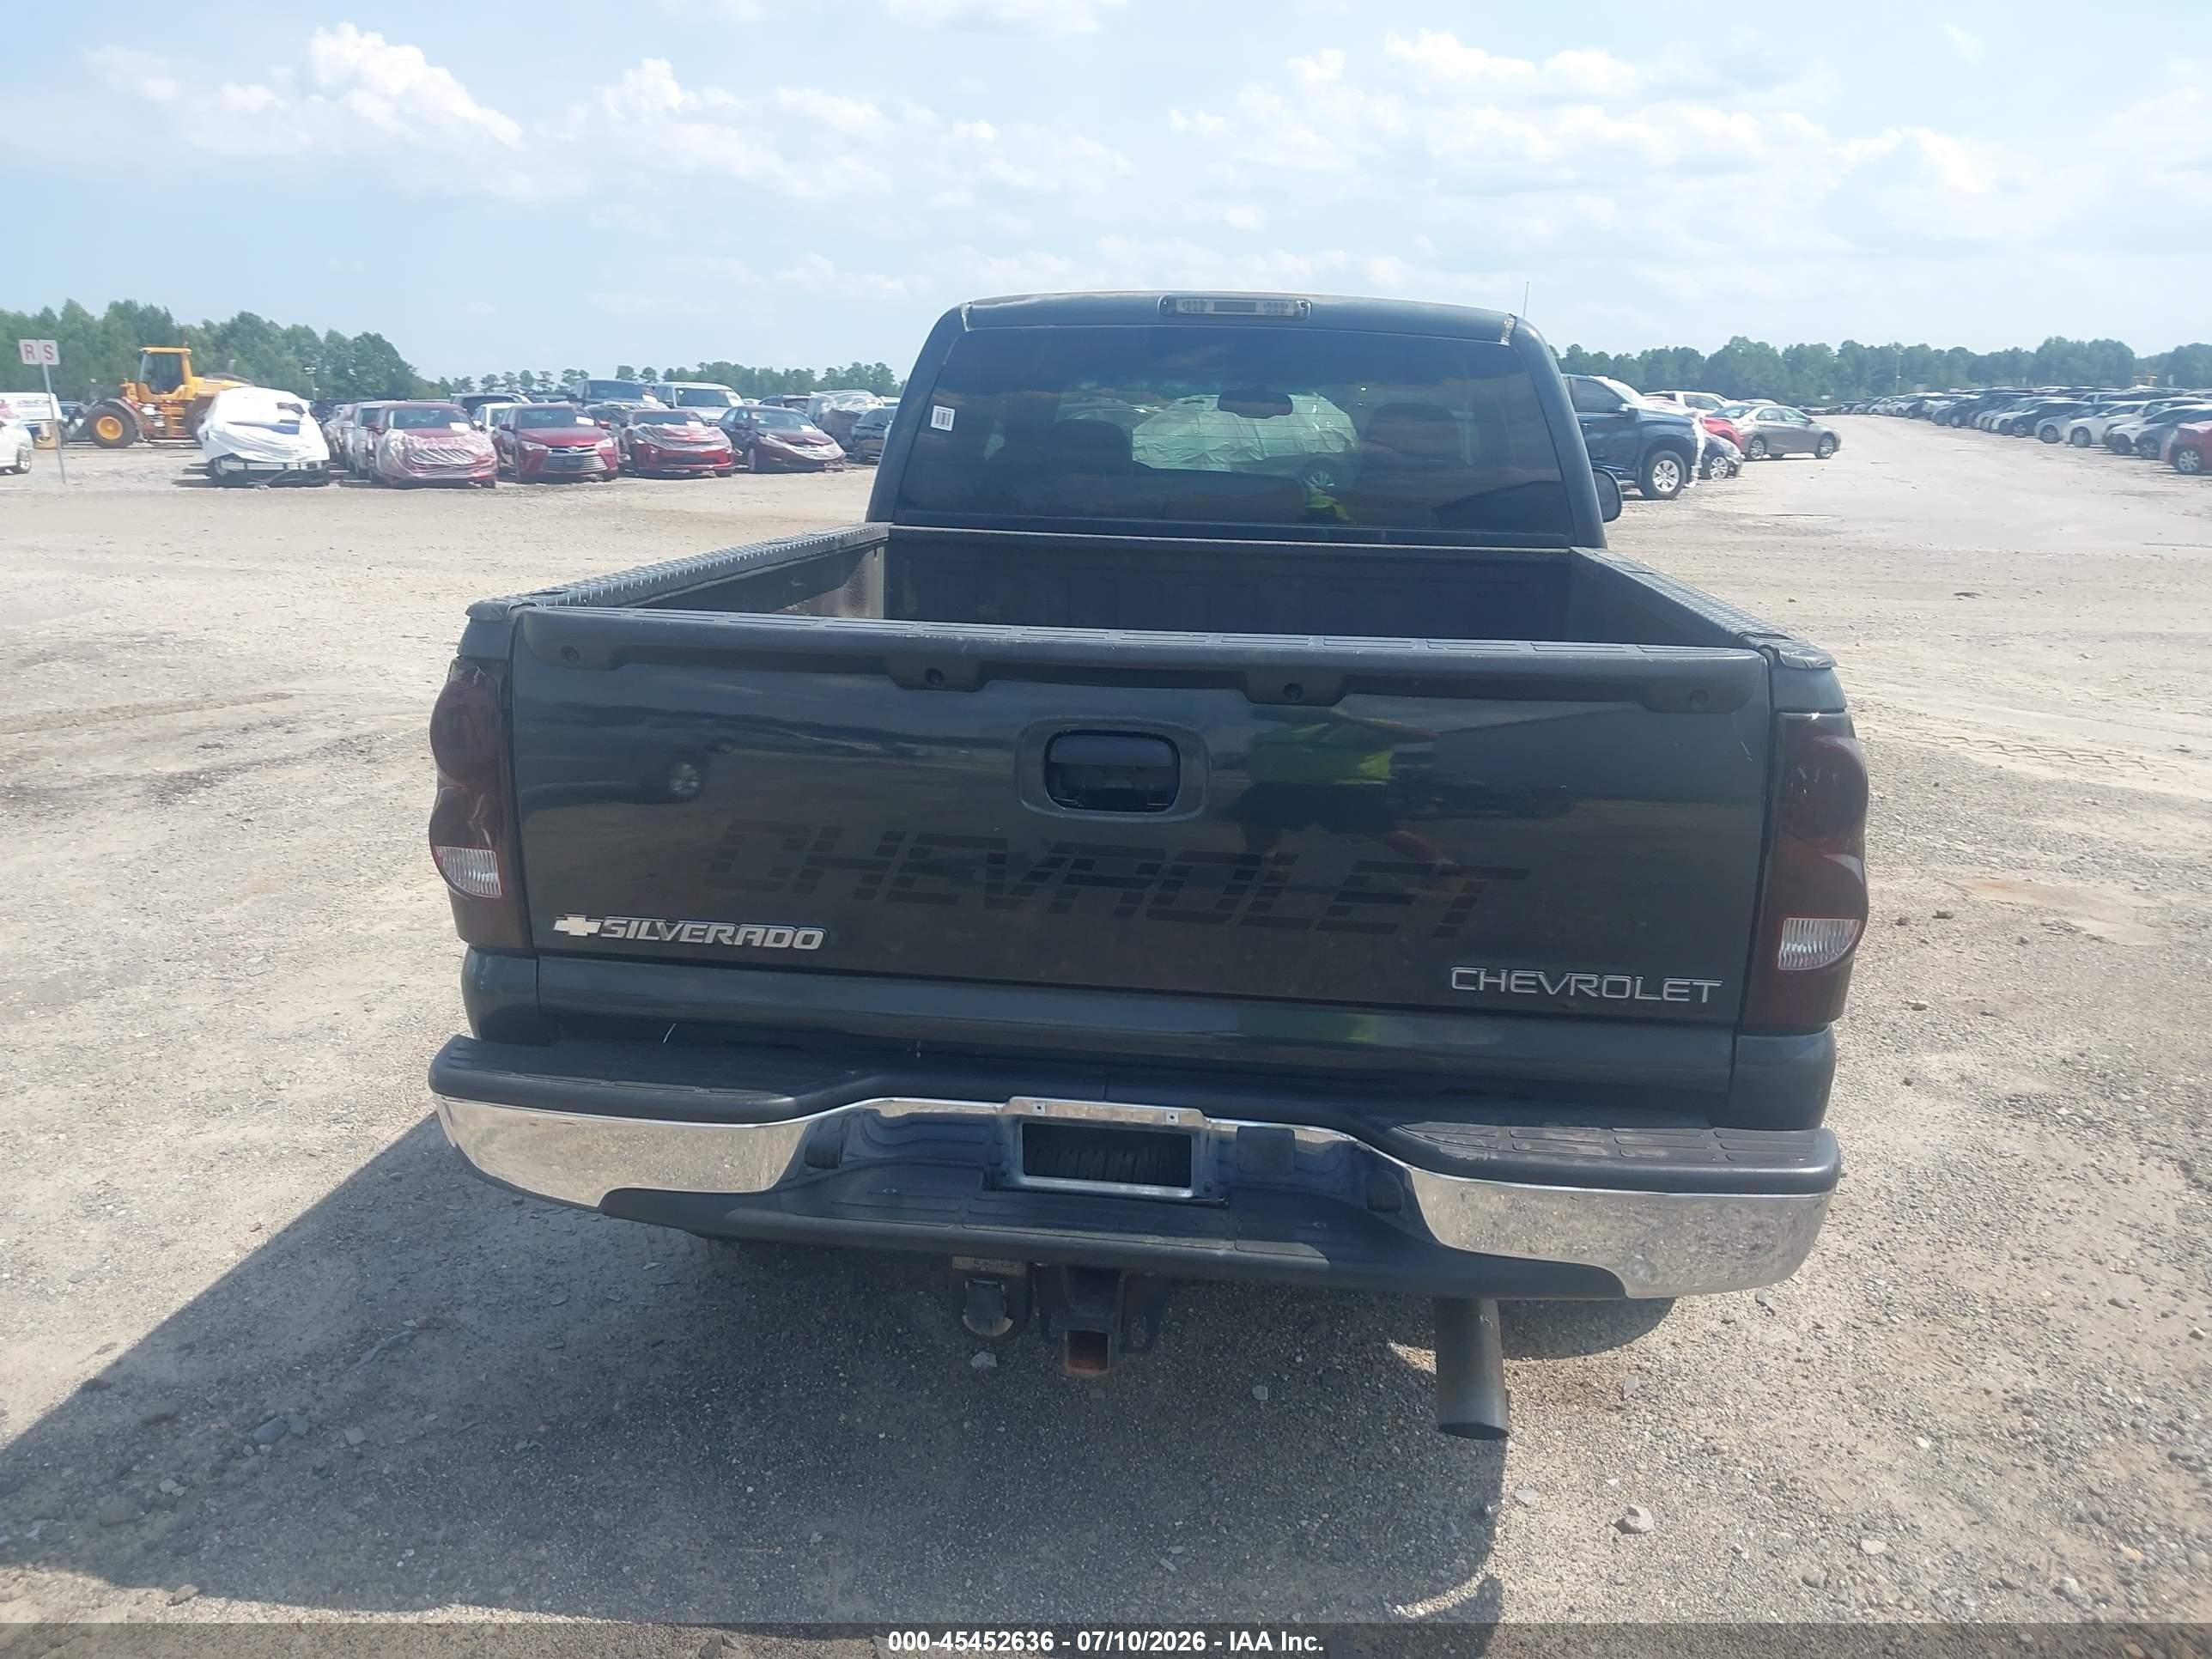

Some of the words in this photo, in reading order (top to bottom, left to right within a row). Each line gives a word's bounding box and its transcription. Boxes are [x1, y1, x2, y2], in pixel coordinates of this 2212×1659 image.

[24, 343, 36, 360] R
[43, 344, 54, 361] S
[702, 818, 1532, 939] CHEVROLET
[601, 915, 828, 950] SILVERADO
[1450, 967, 1723, 1003] CHEVROLET
